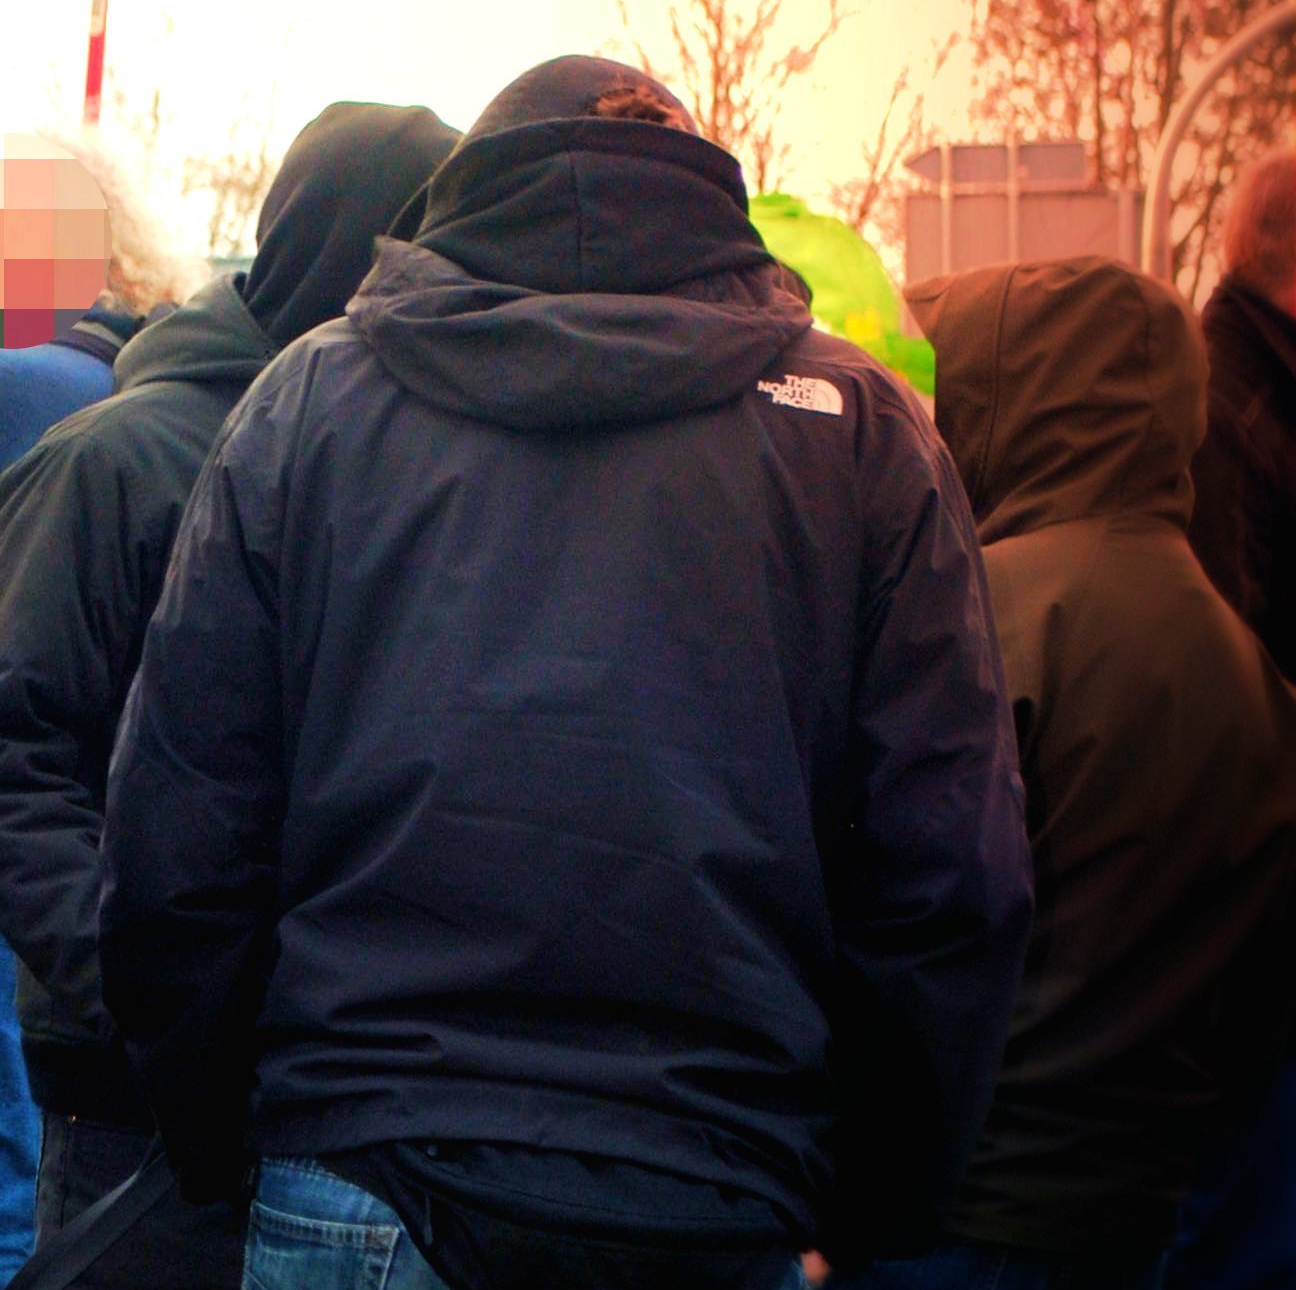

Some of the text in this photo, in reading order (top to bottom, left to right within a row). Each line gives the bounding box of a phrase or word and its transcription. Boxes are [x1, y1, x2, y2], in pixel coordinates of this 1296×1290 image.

[757, 380, 817, 399] NORTH
[783, 374, 817, 390] THE
[772, 392, 817, 410] FACE
